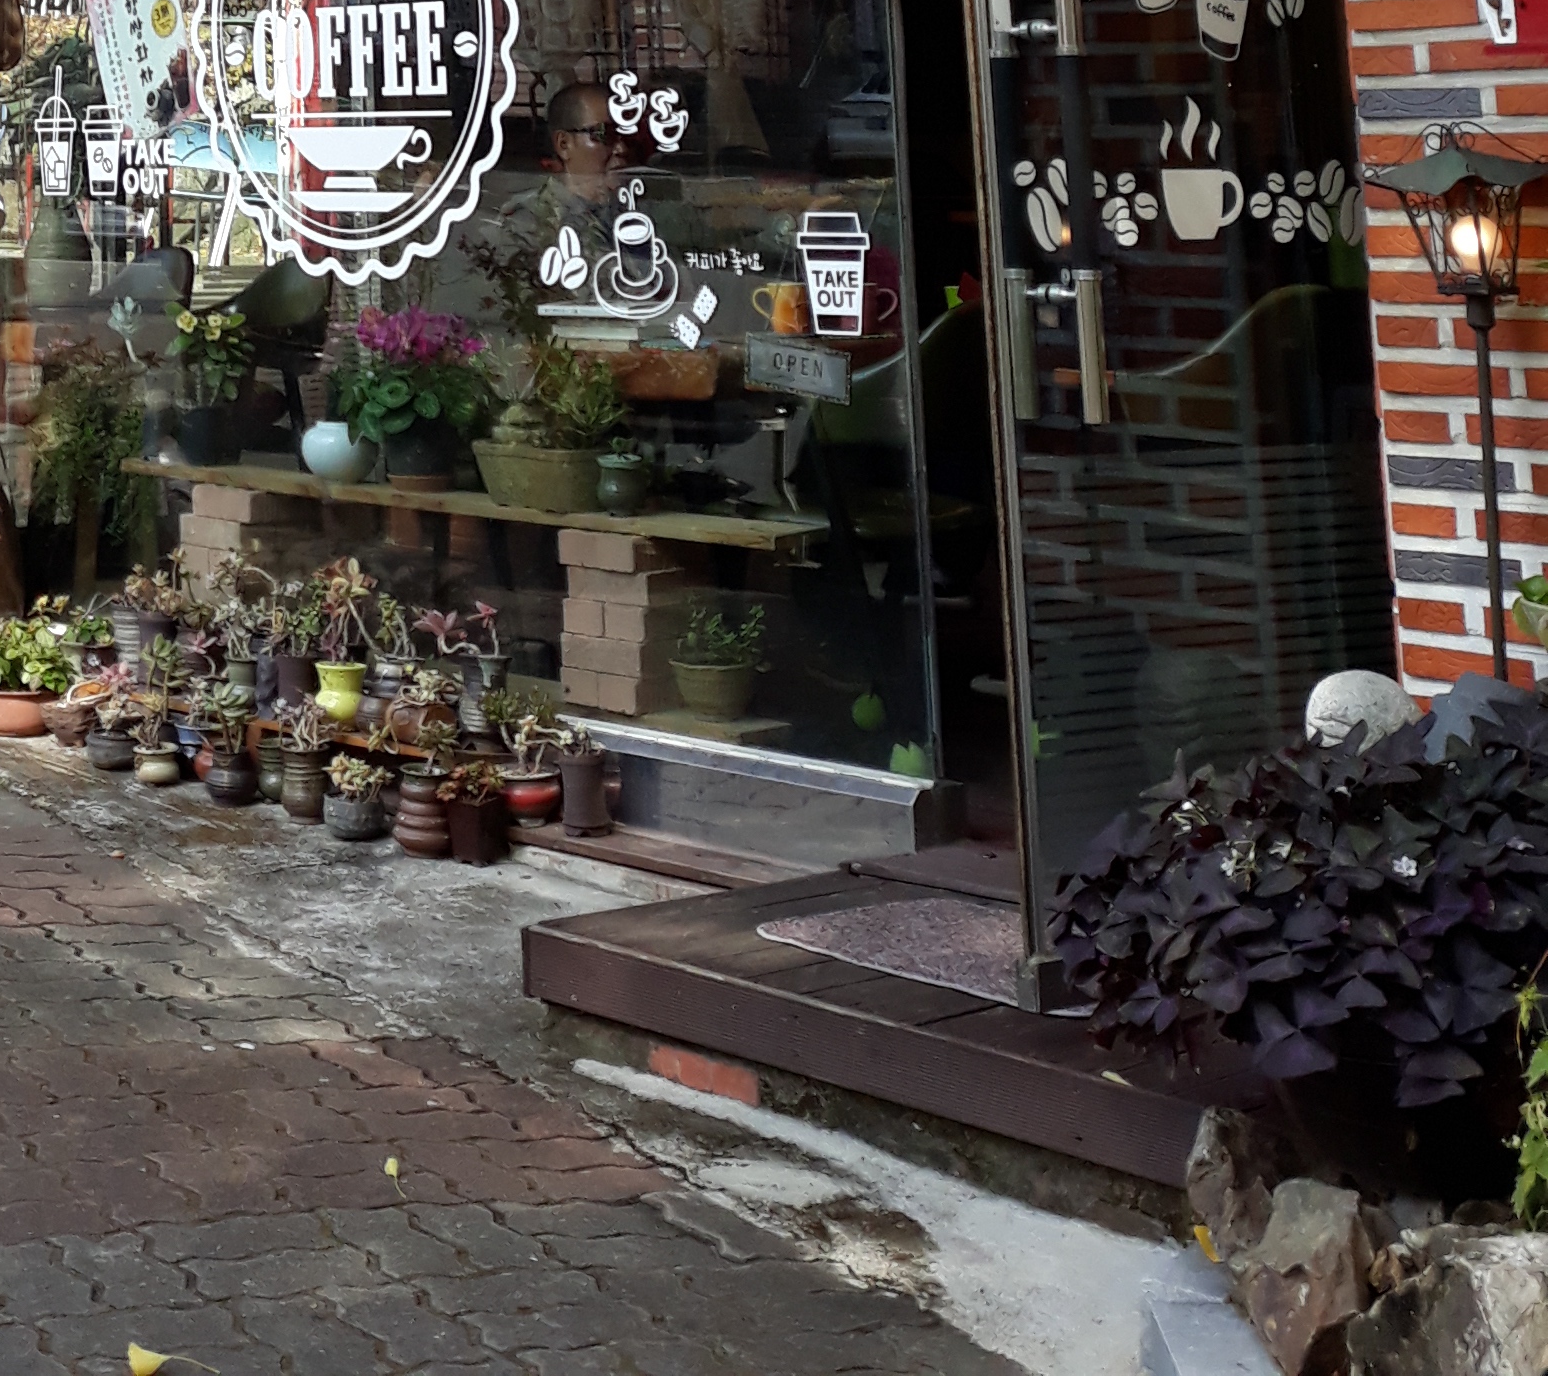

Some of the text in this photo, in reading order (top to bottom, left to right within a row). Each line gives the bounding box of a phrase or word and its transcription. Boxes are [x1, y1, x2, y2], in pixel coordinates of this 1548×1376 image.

[252, 0, 449, 99] COFFEE
[121, 138, 176, 165] TAKE
[122, 167, 169, 195] OUT
[684, 247, 765, 277] 커피가 좋아요
[811, 270, 859, 289] TAKE
[817, 289, 856, 308] OUT
[773, 352, 823, 379] OPEN
